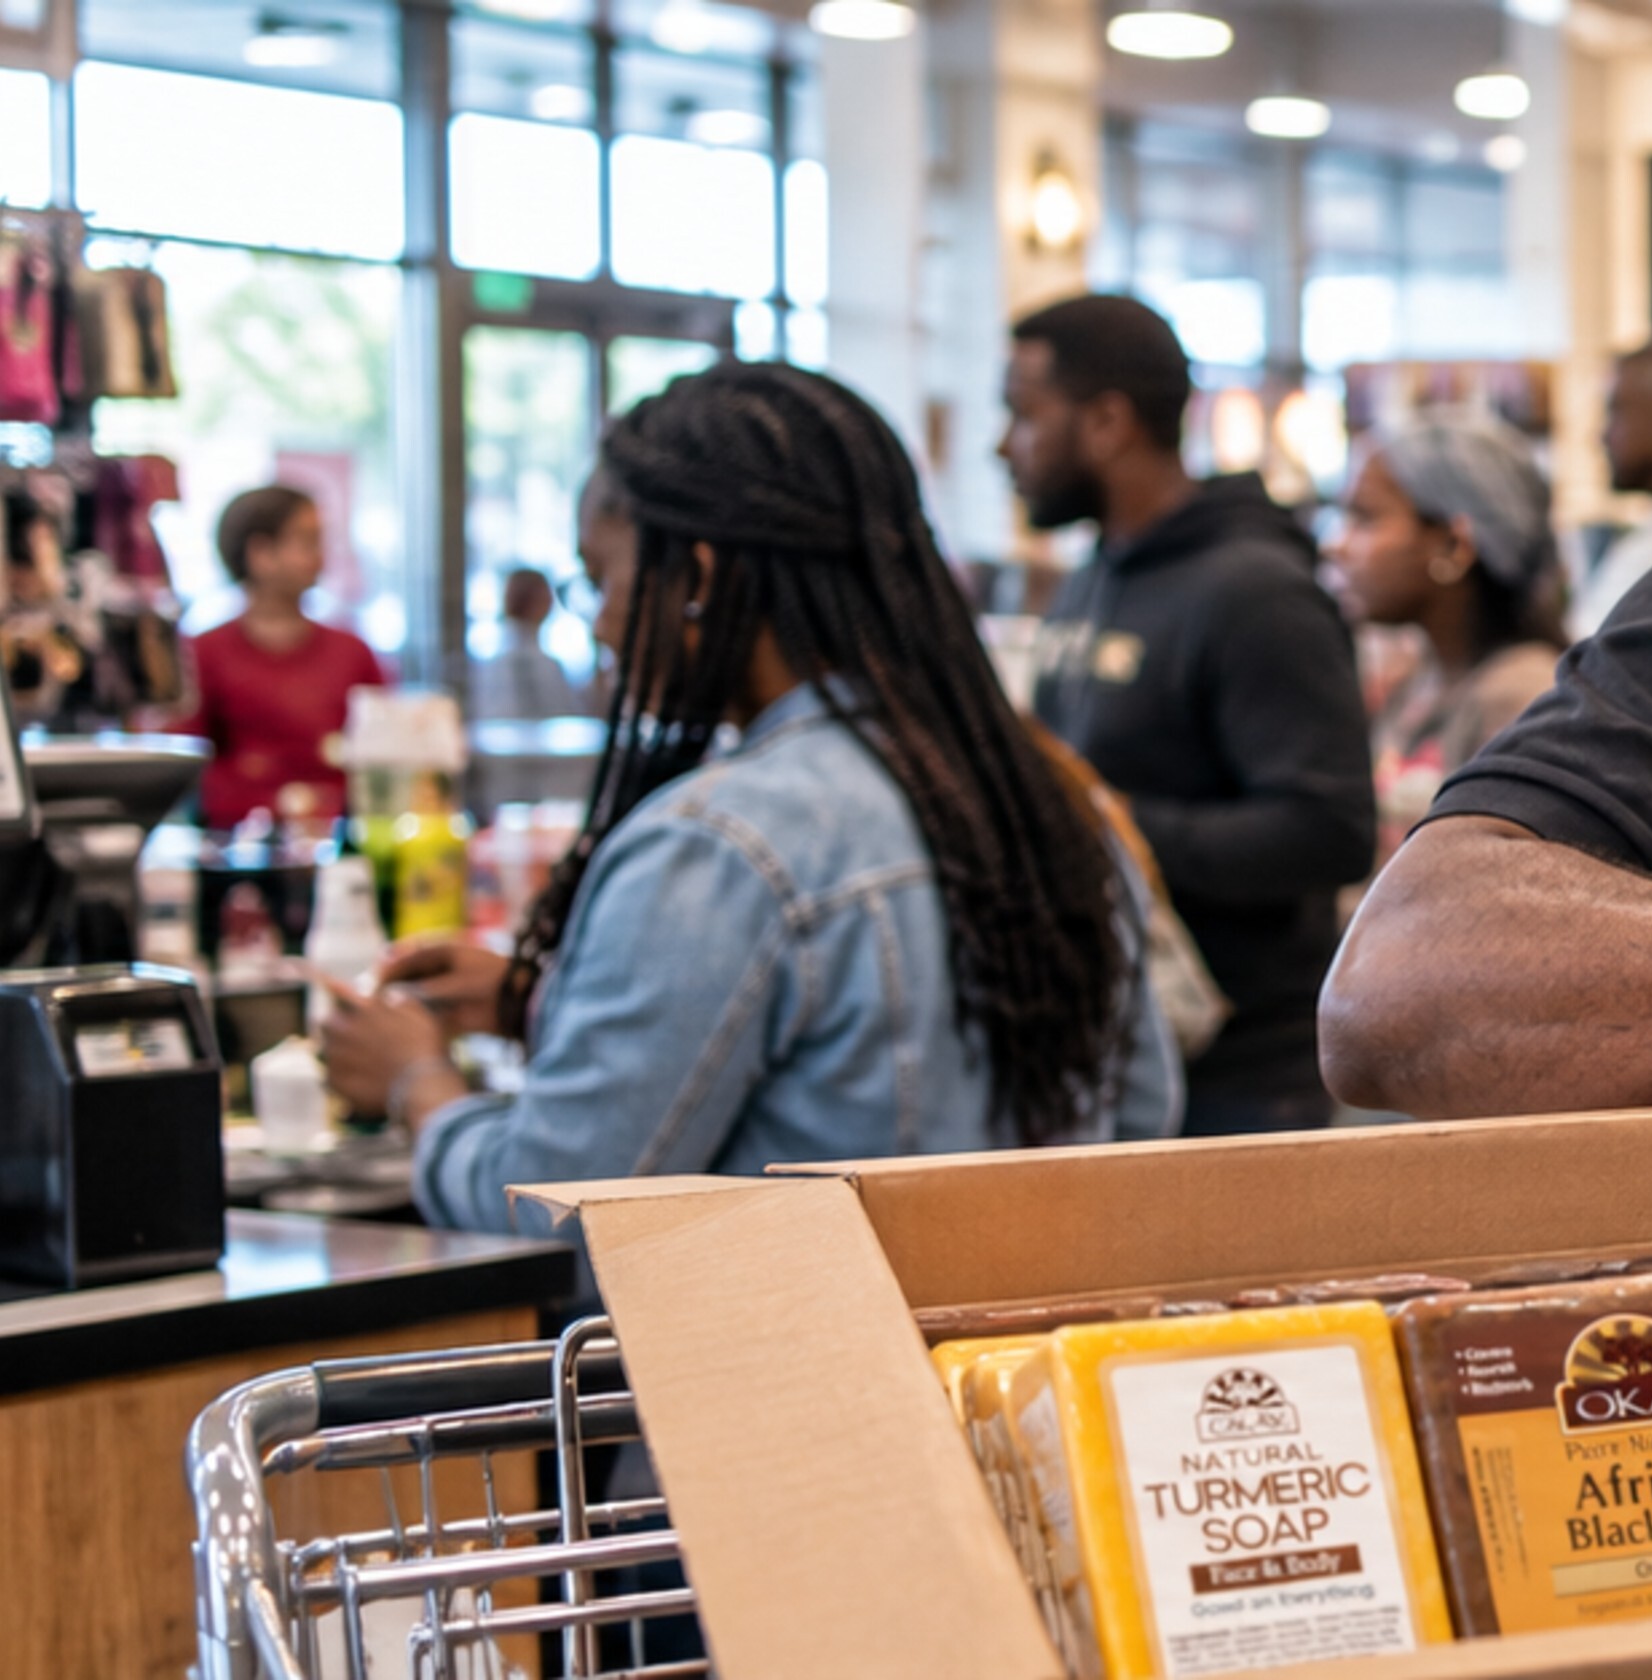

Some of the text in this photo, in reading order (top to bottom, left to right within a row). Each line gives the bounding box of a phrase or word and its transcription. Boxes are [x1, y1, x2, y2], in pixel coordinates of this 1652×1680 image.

[1181, 1442, 1323, 1474] NATURAL
[1144, 1461, 1371, 1519] TURMERIC
[1202, 1507, 1329, 1553] SOAP
